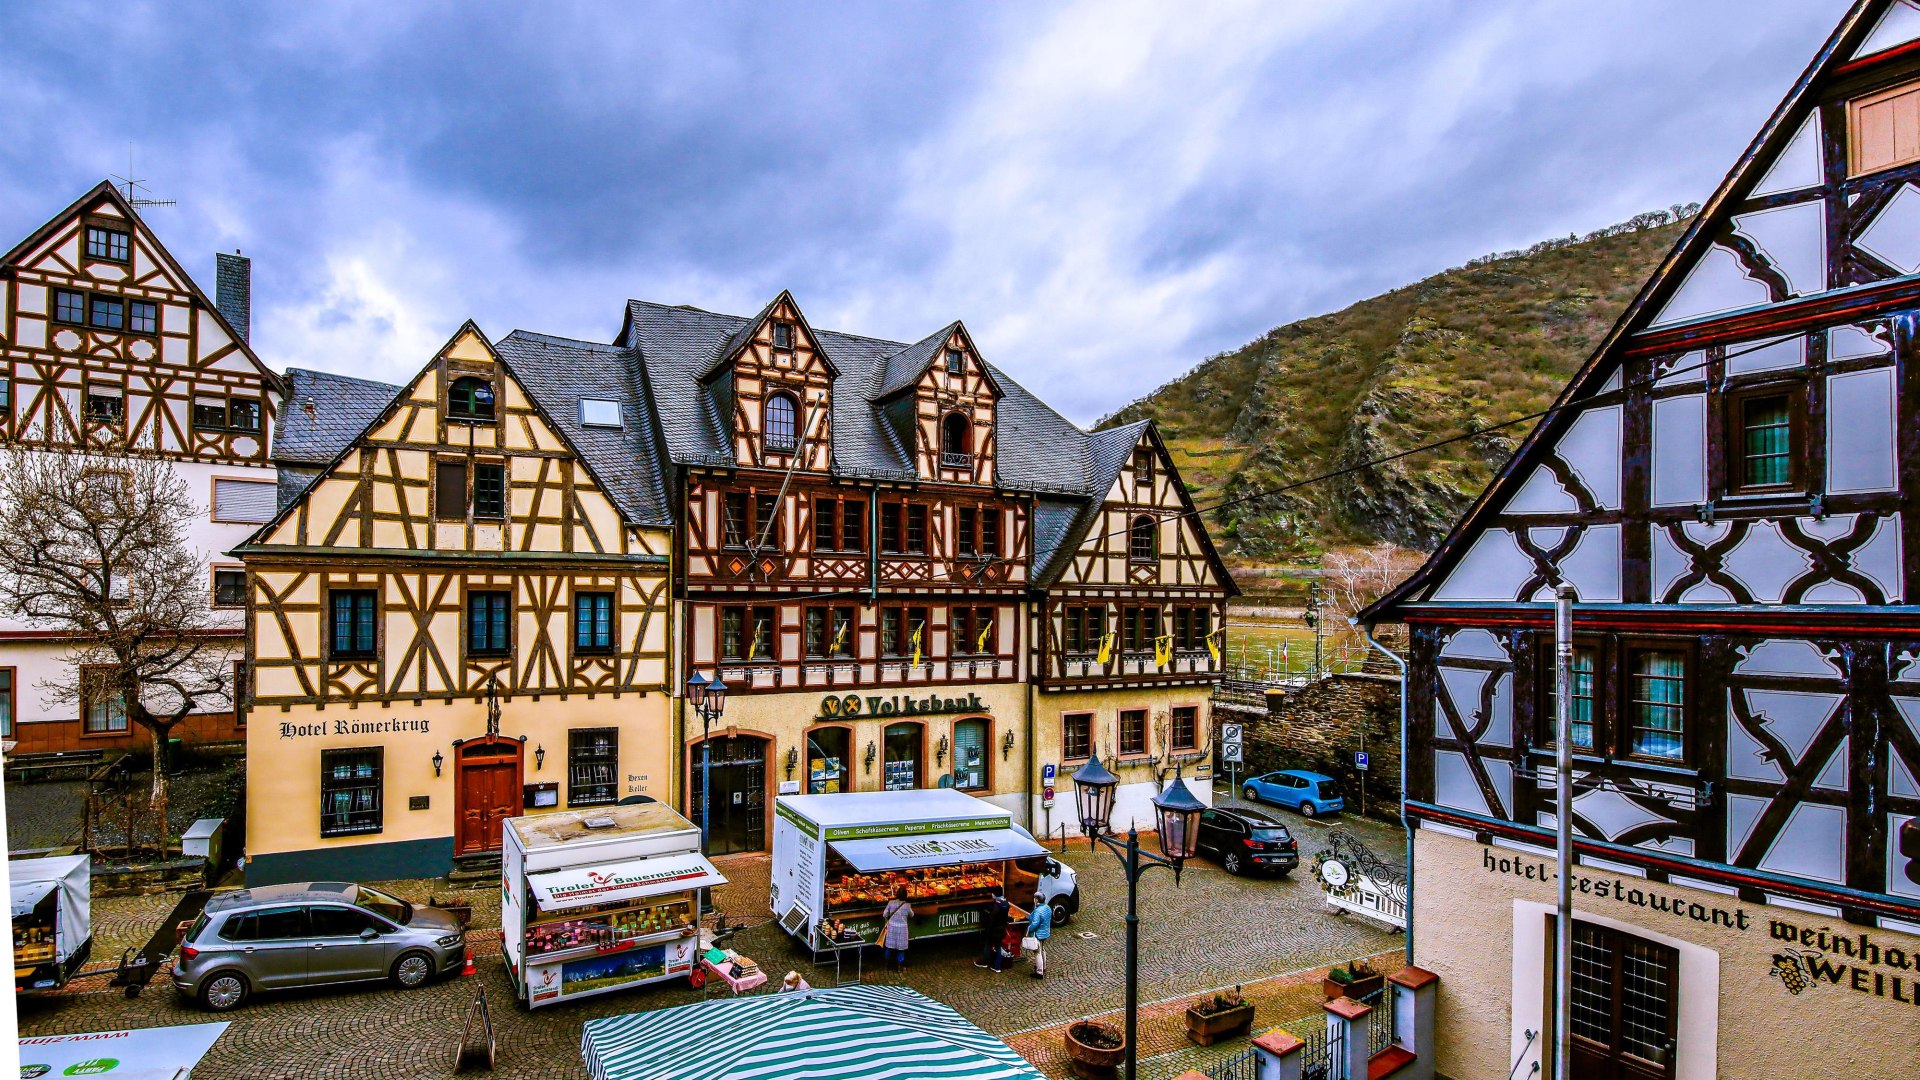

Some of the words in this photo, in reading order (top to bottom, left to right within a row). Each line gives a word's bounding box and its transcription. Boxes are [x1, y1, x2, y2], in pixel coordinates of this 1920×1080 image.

[866, 693, 982, 713] Volksbank
[280, 721, 327, 739] Hotel
[334, 718, 430, 735] Römerkrug
[1358, 753, 1365, 762] P
[628, 774, 648, 782] Hexen
[1046, 766, 1053, 777] P
[905, 824, 926, 832] Peperoni
[545, 881, 596, 894] Tiroler
[613, 865, 705, 884] Bauernstandl
[938, 911, 970, 928] FEINKST
